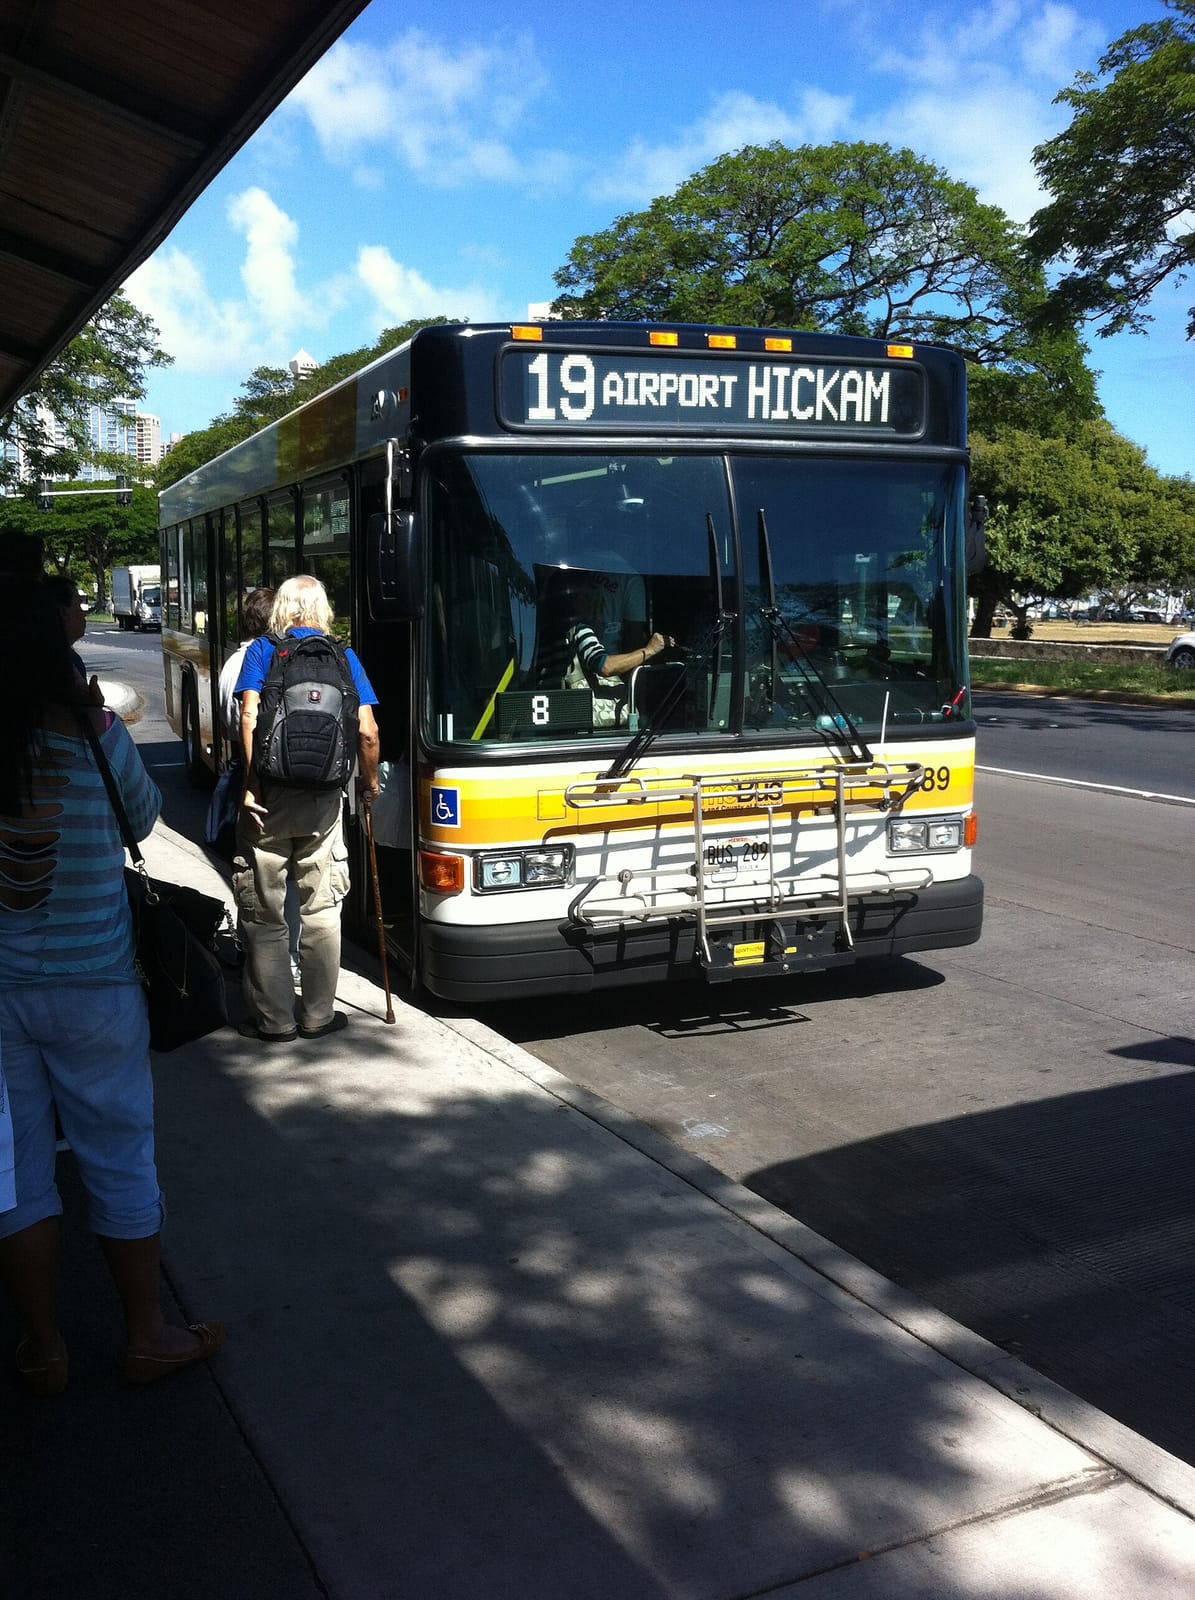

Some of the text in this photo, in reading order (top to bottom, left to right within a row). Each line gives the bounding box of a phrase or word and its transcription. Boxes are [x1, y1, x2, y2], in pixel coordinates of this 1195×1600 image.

[528, 353, 890, 423] 19 AIRPORT HICKAM
[532, 695, 550, 725] 8
[708, 841, 768, 865] BUS 289
